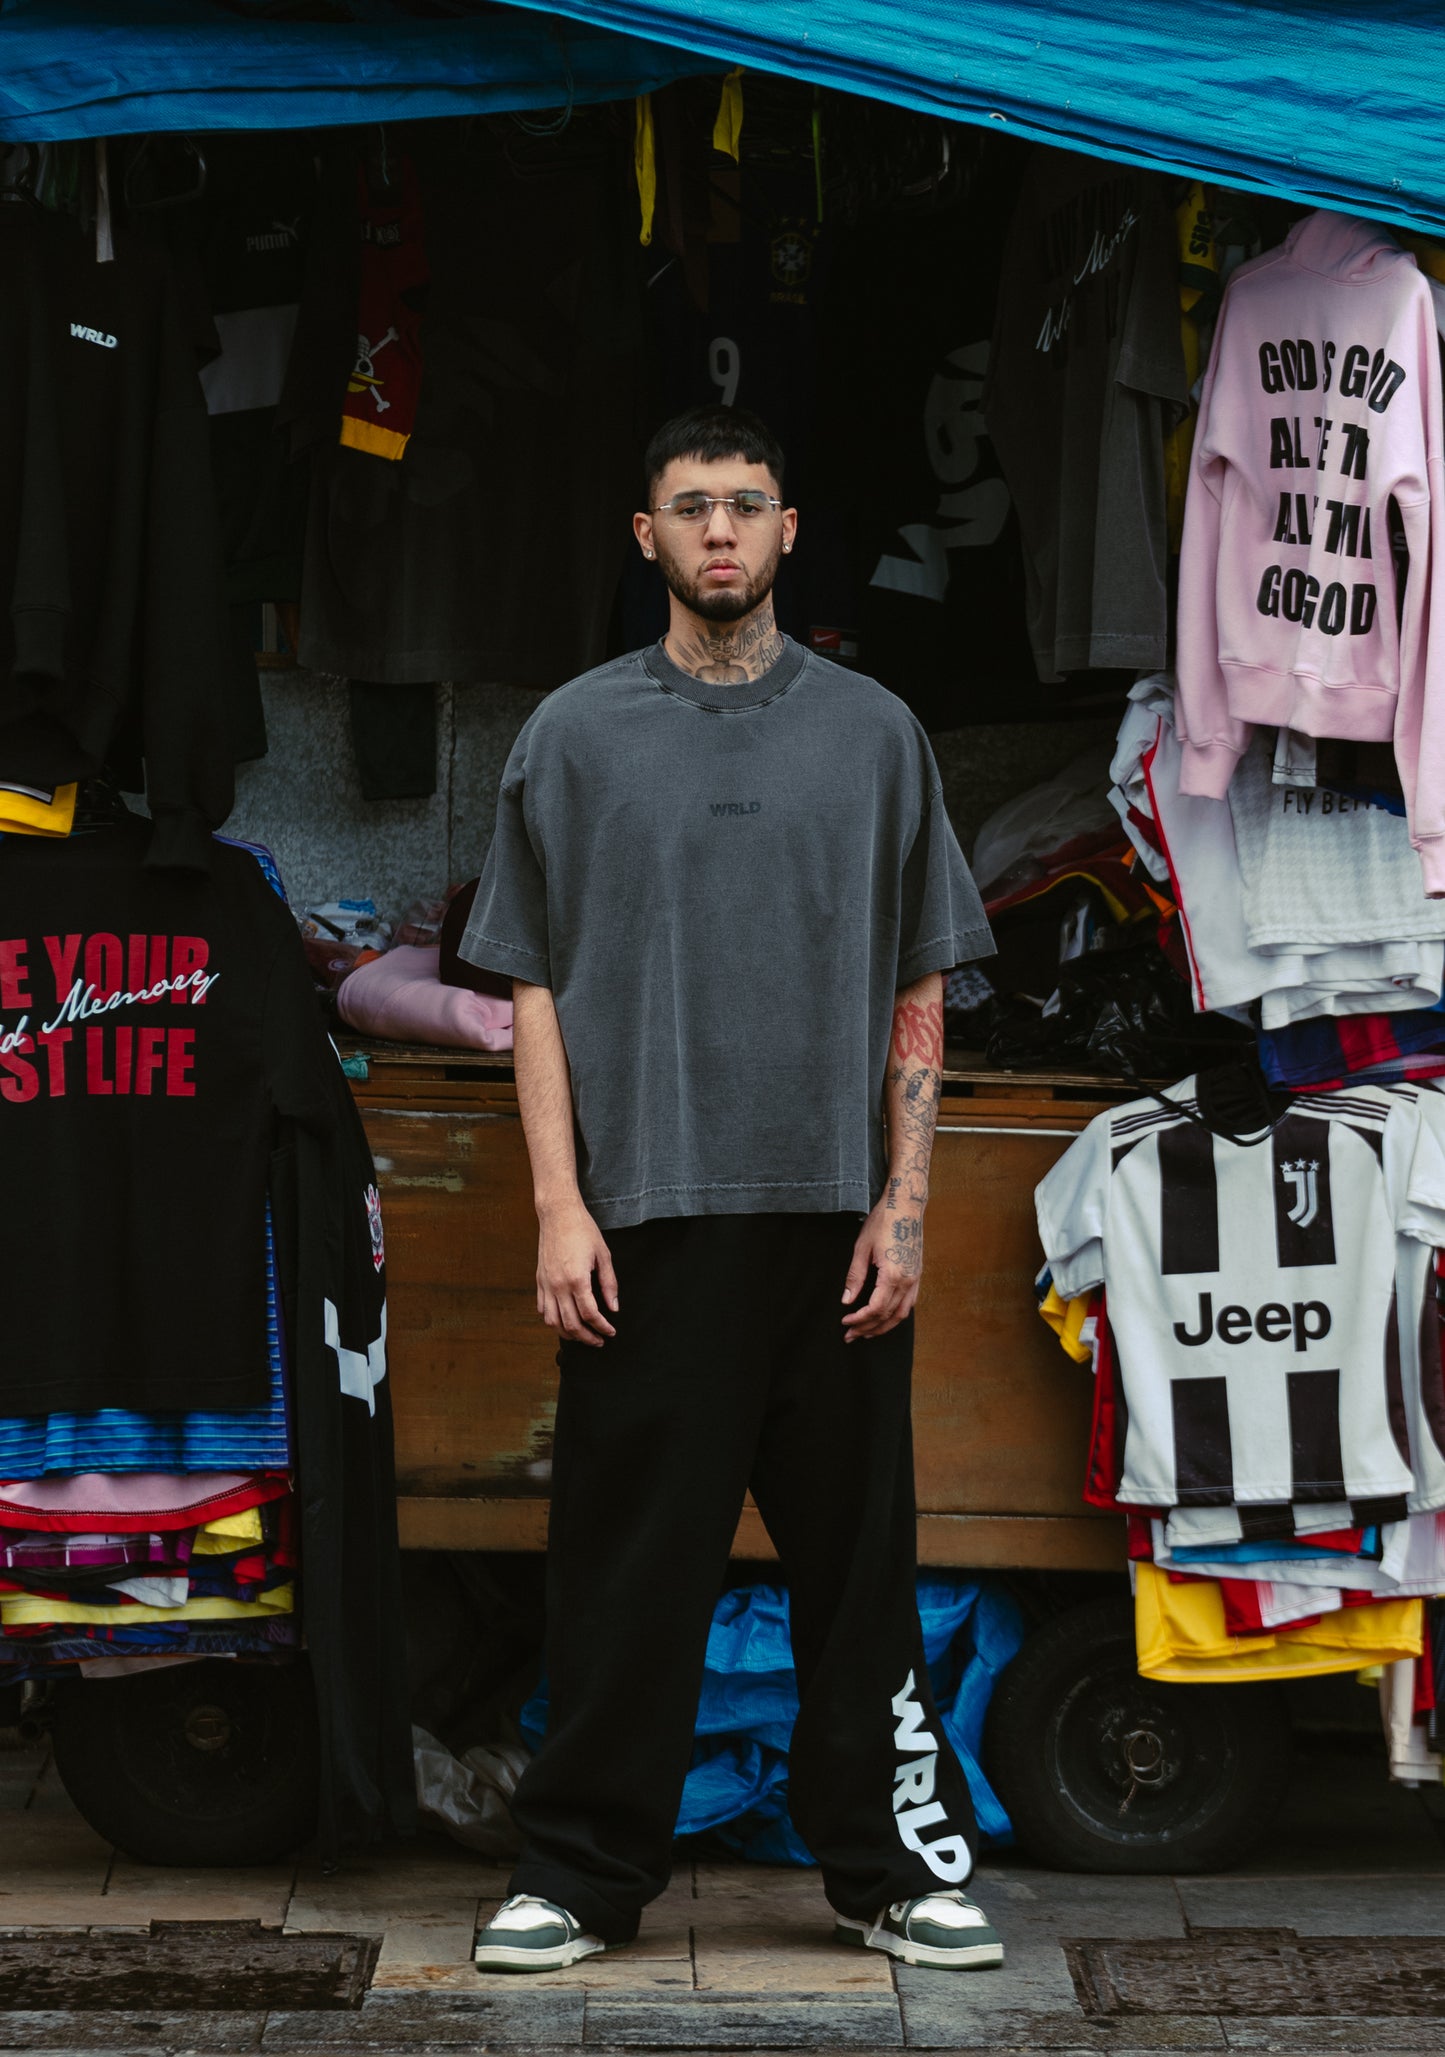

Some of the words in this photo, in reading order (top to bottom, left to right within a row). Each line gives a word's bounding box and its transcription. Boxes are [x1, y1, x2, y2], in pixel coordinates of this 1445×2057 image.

[69, 322, 119, 349] WRLD
[709, 337, 740, 407] 9
[709, 801, 761, 817] WRLD
[1283, 790, 1314, 815] FLY
[43, 932, 210, 1004] YOUR
[42, 969, 220, 1034] Memory
[86, 1026, 196, 1097] LIFE
[1173, 1292, 1332, 1353] Jeep
[891, 1667, 973, 1884] WRLD
